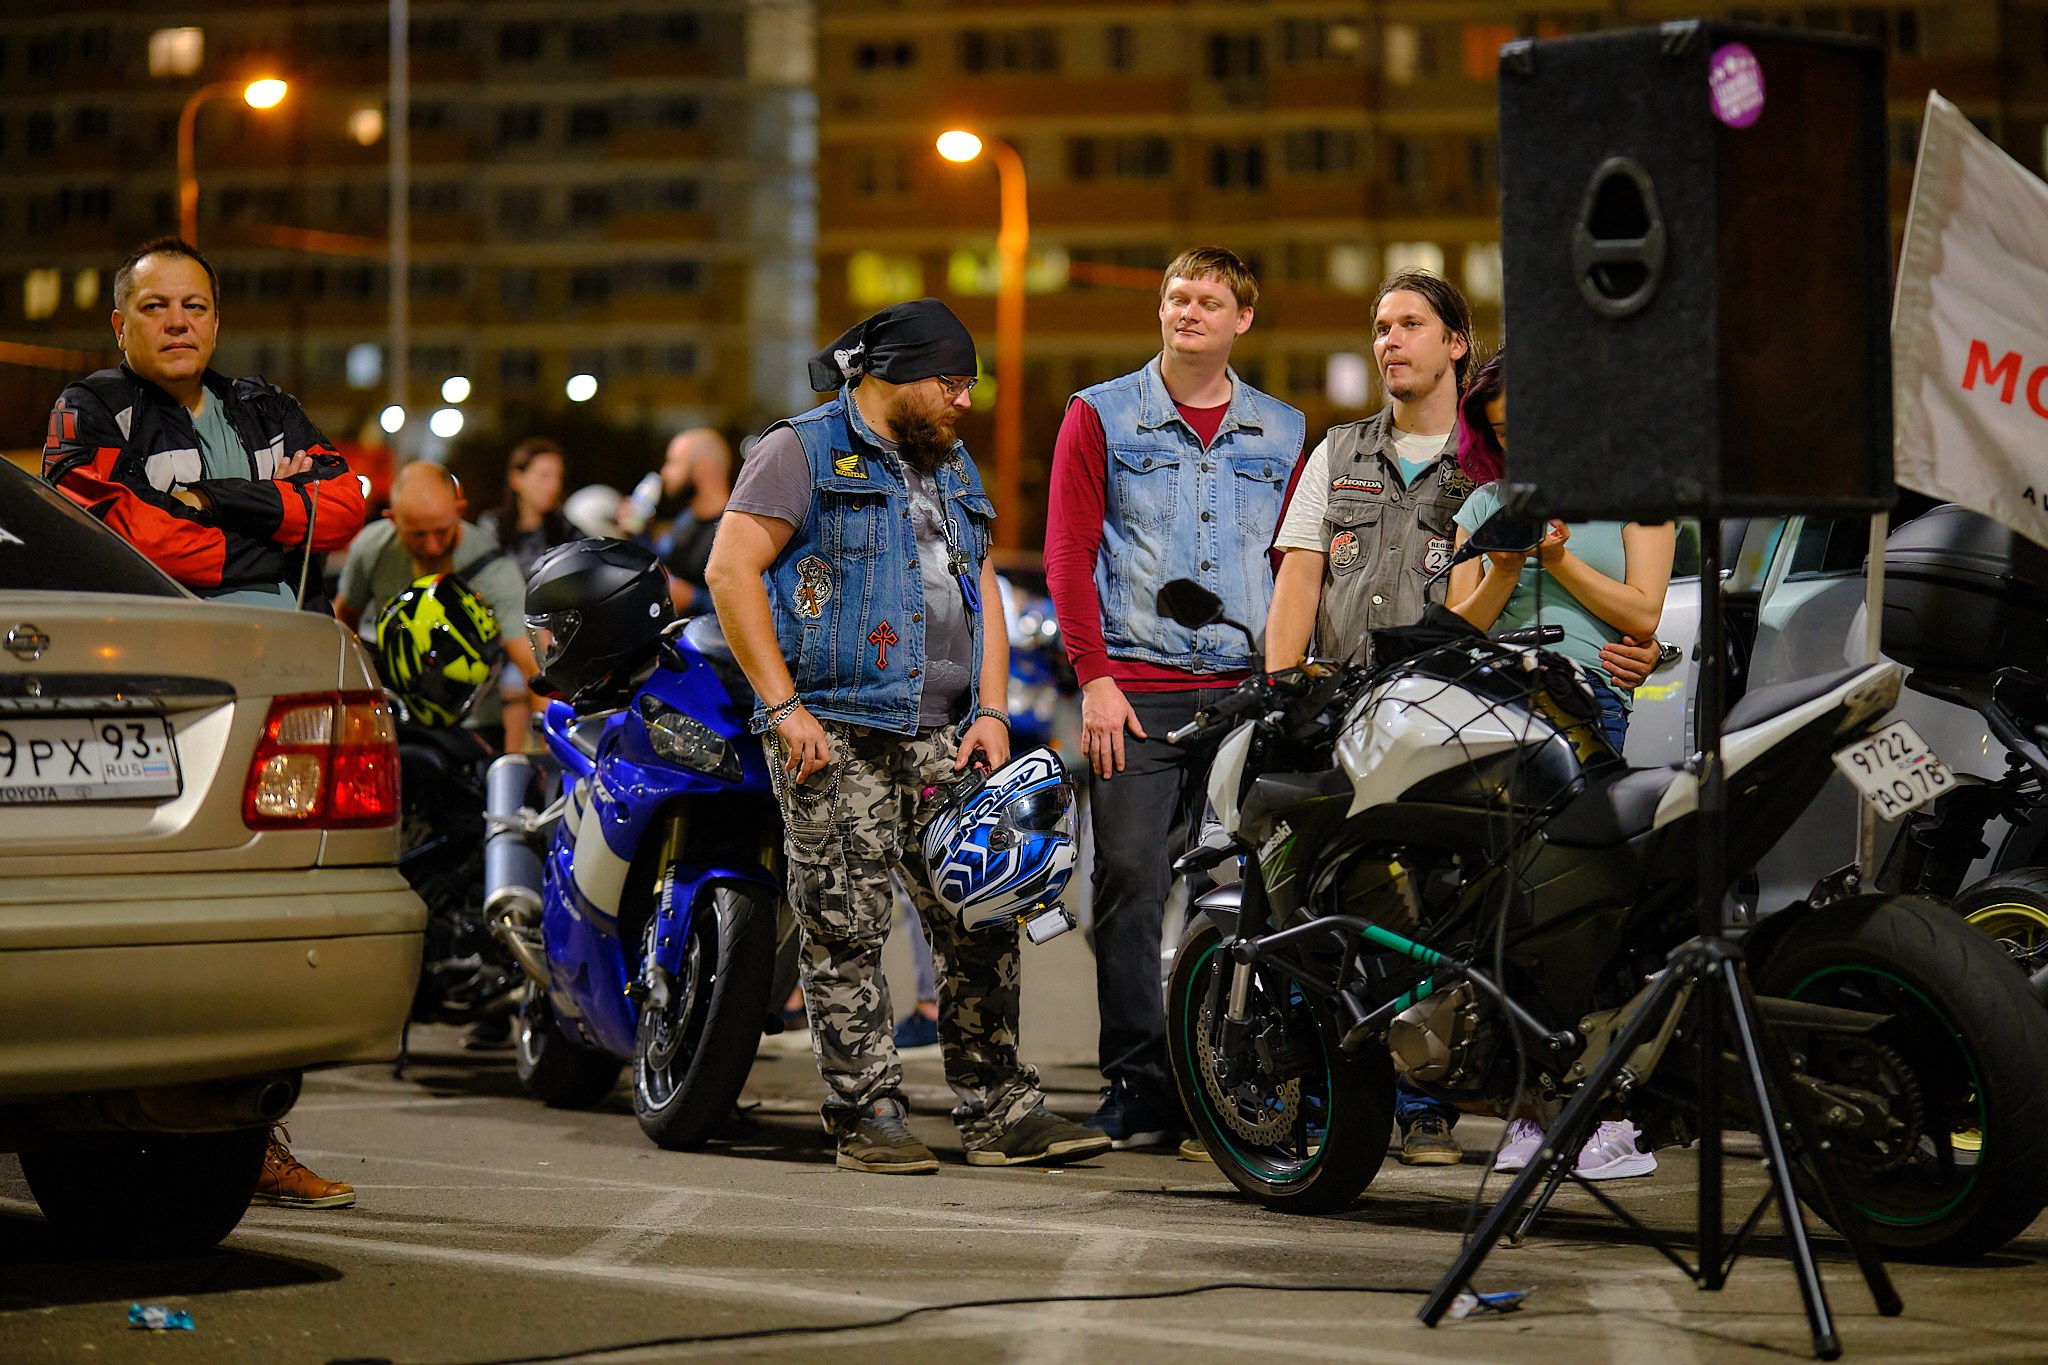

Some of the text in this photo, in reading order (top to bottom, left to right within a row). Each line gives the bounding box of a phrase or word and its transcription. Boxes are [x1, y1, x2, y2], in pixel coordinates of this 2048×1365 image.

[835, 469, 868, 478] HONDA
[1343, 479, 1383, 488] HONDA
[101, 723, 151, 760] 93
[1852, 732, 1912, 774] 9722
[105, 762, 142, 777] RUS
[1911, 764, 1945, 793] 78
[660, 864, 676, 912] YAMAHA
